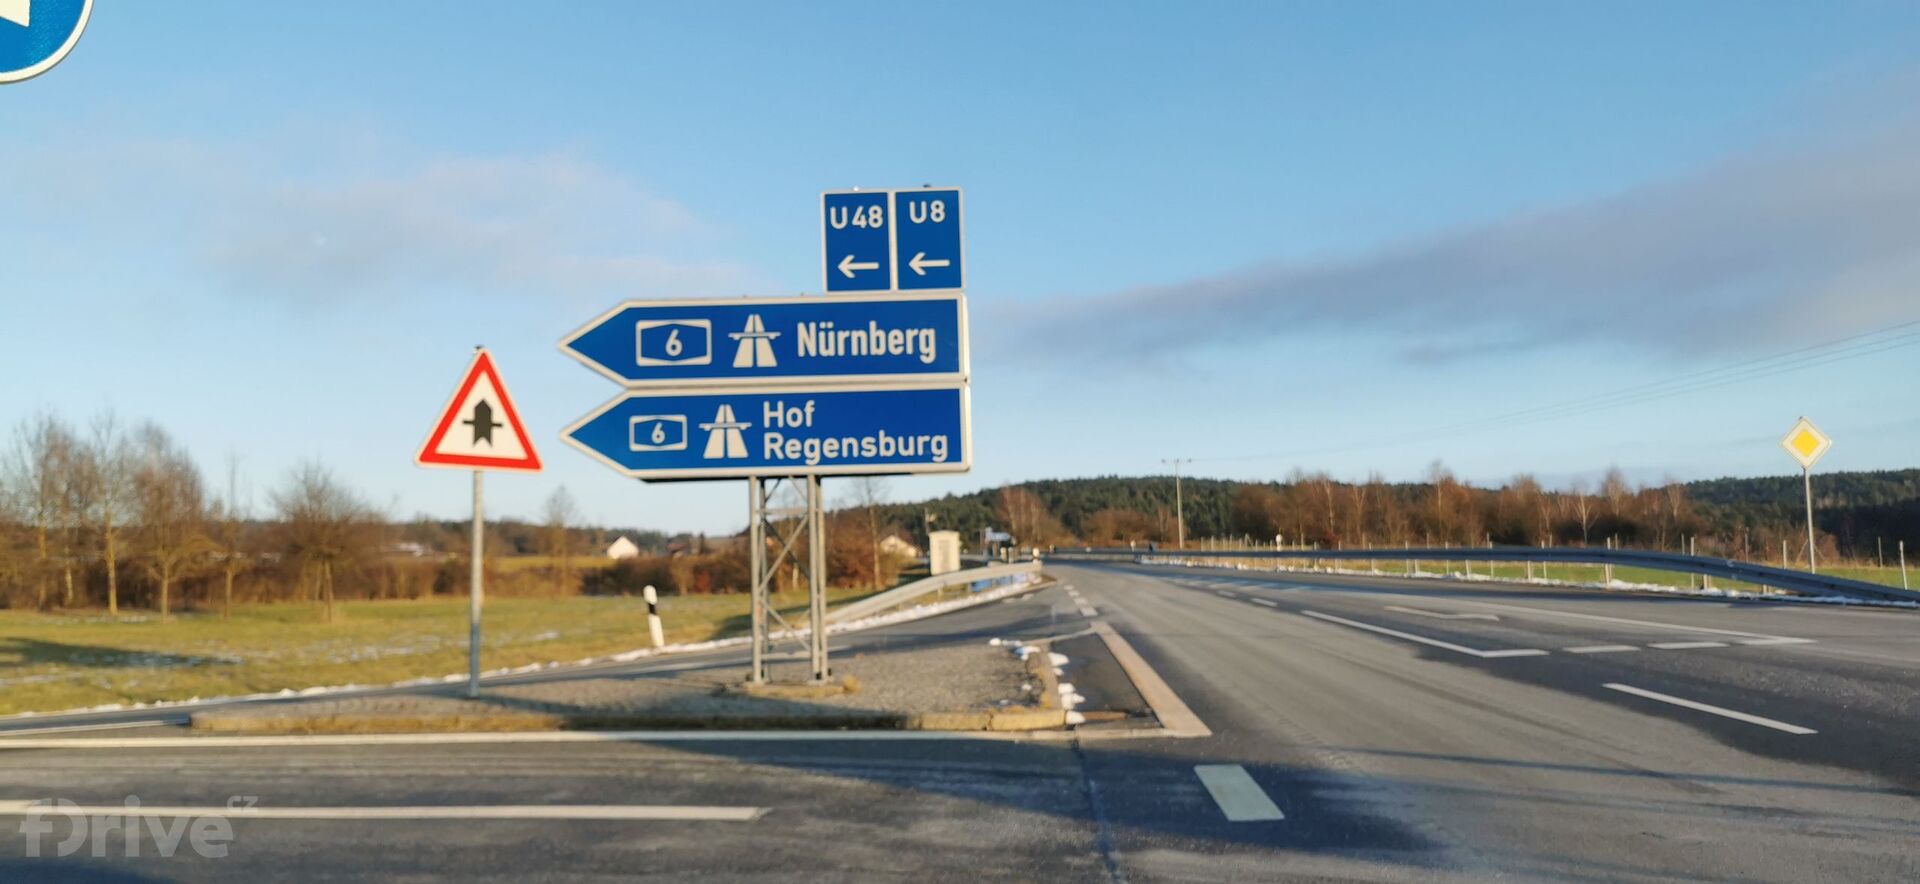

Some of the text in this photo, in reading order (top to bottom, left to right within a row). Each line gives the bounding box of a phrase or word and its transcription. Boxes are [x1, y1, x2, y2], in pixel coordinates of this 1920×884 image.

[664, 321, 937, 364] 6 Nürnberg
[763, 400, 816, 428] Hof
[650, 422, 666, 444] 6
[763, 429, 948, 465] Regensburg
